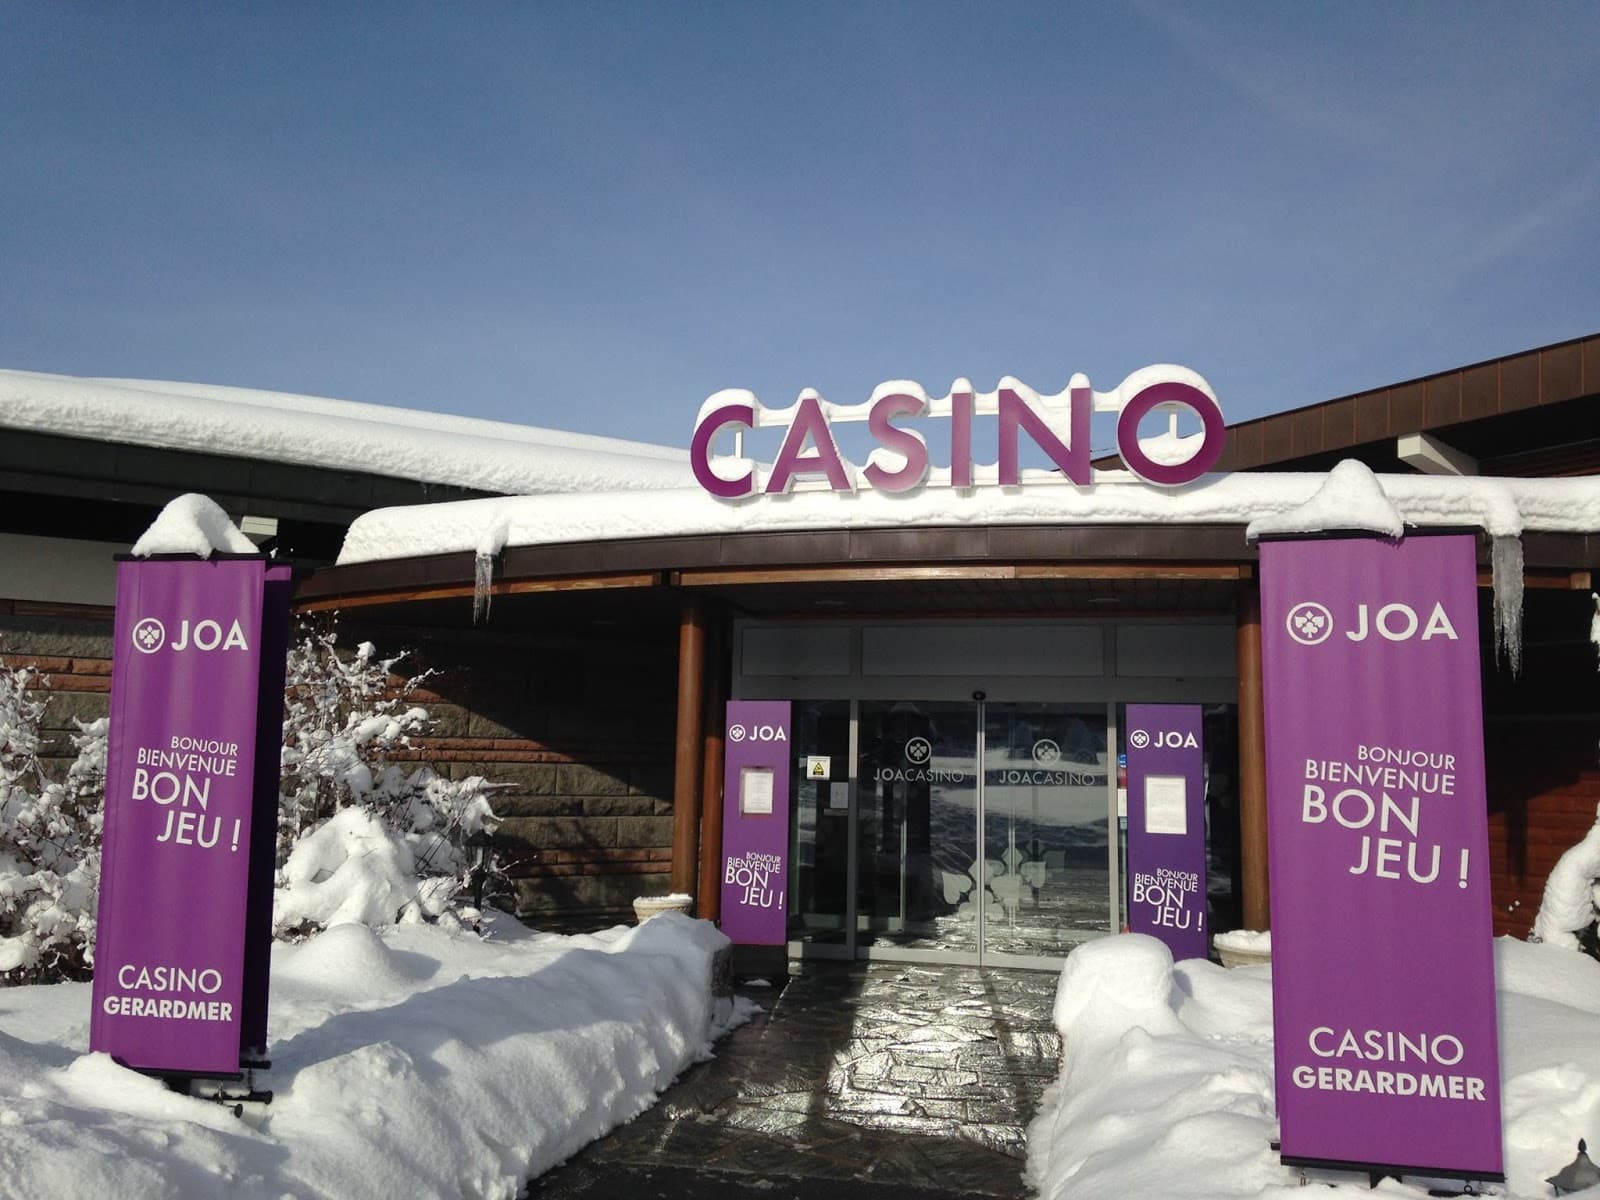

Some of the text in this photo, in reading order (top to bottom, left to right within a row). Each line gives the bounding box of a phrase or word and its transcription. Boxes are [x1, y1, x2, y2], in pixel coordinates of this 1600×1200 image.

[690, 381, 1226, 499] CASINO
[171, 619, 249, 652] JOA
[1345, 602, 1459, 642] JOA
[170, 735, 238, 757] BONJOUR
[749, 725, 787, 742] JOA
[1153, 730, 1199, 749] JOA
[137, 747, 236, 777] BIENVENUE
[1357, 744, 1456, 771] BONJOUR
[131, 767, 211, 811] BON
[1304, 758, 1456, 796] BIENVENUE
[1301, 783, 1420, 838] BON
[156, 809, 222, 849] JEU
[727, 856, 781, 874] BIENVENUE
[746, 851, 782, 864] BONJOUR
[1348, 835, 1441, 884] JEU
[725, 866, 769, 889] BON
[1134, 872, 1199, 893] BIENVENUE
[1156, 867, 1199, 882] BONJOUR
[739, 886, 774, 908] JEU
[1133, 883, 1185, 909] BON
[1151, 905, 1191, 929] JEU
[118, 964, 222, 994] CASINO
[103, 994, 233, 1022] GERARDMER
[1308, 1026, 1464, 1066] CASINO
[1292, 1065, 1486, 1102] GERARDMER
